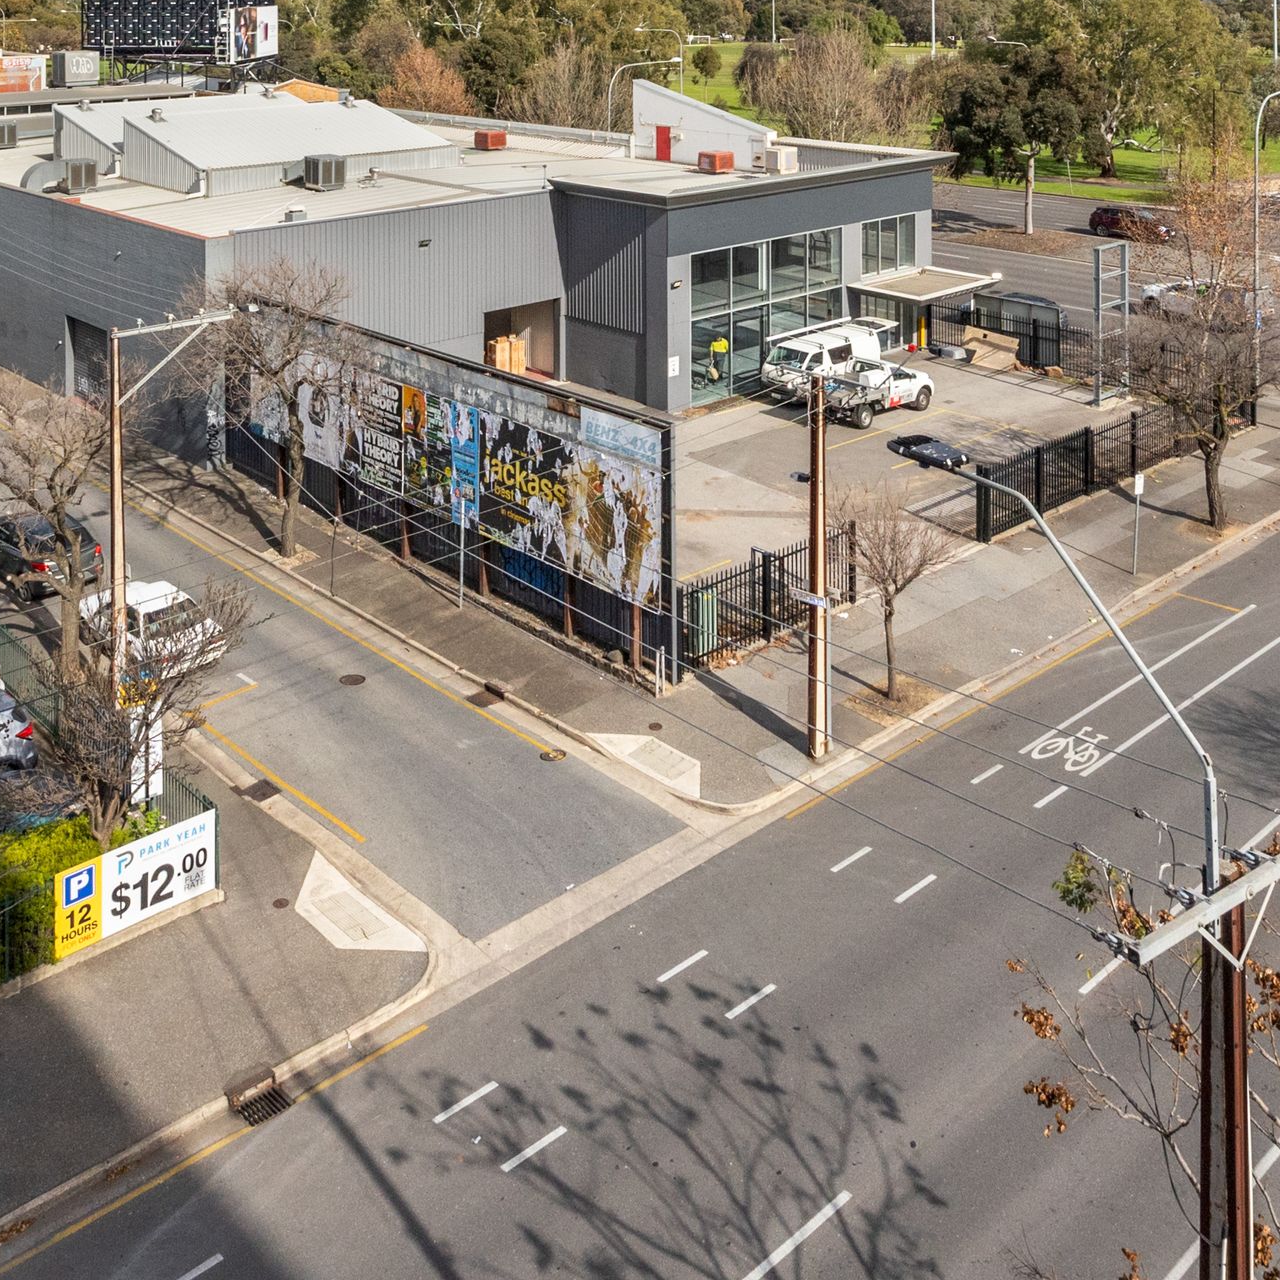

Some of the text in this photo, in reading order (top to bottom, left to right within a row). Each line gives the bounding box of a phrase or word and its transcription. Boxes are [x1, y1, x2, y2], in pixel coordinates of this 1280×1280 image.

[364, 428, 400, 453] HYBRID
[585, 421, 621, 442] BENZ
[364, 442, 400, 467] THEORY
[484, 448, 567, 508] jackass
[494, 481, 514, 501] best
[139, 837, 170, 858] PARK
[176, 823, 206, 841] YEAH
[70, 870, 90, 901] P
[183, 876, 206, 892] RATE
[184, 870, 205, 883] FLAT
[66, 903, 91, 929] 12
[61, 920, 98, 944] HOURS
[78, 930, 97, 944] ONLY
